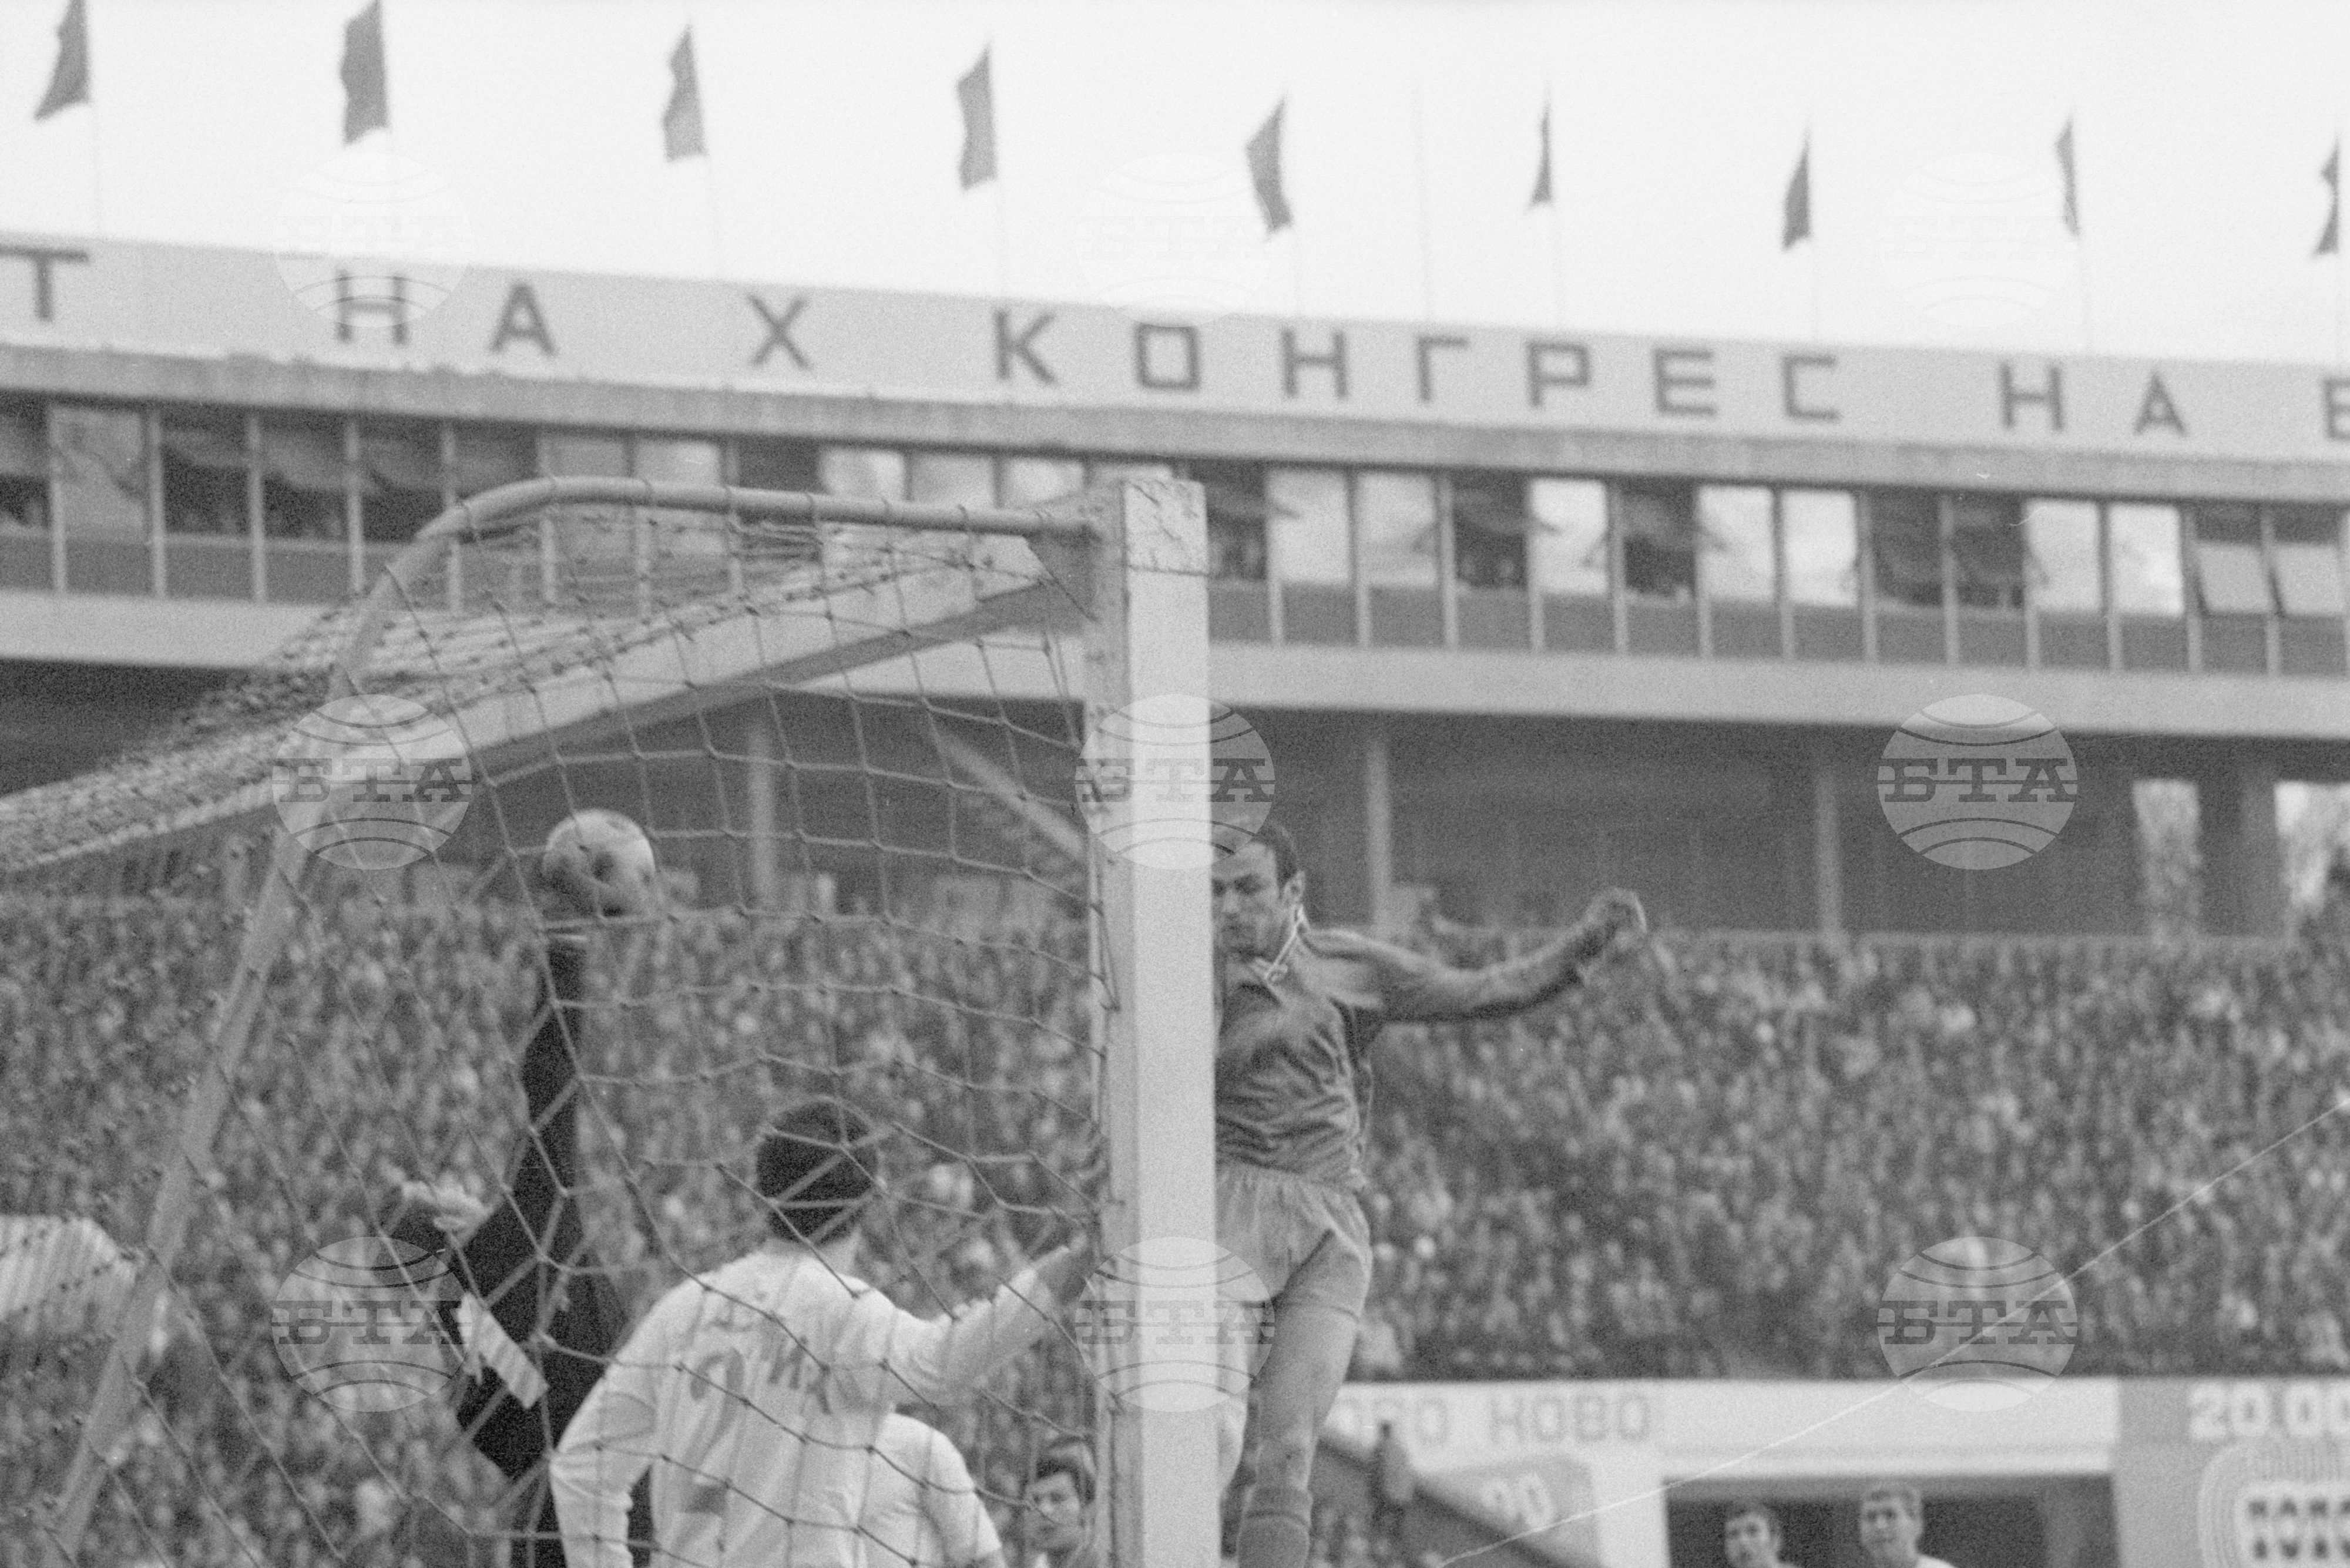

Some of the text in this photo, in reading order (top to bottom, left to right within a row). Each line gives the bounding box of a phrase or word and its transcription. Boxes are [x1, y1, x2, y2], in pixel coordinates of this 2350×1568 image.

[335, 268, 556, 357] НА
[992, 308, 1841, 423] КОНГРЕС
[2000, 361, 2188, 437] НА
